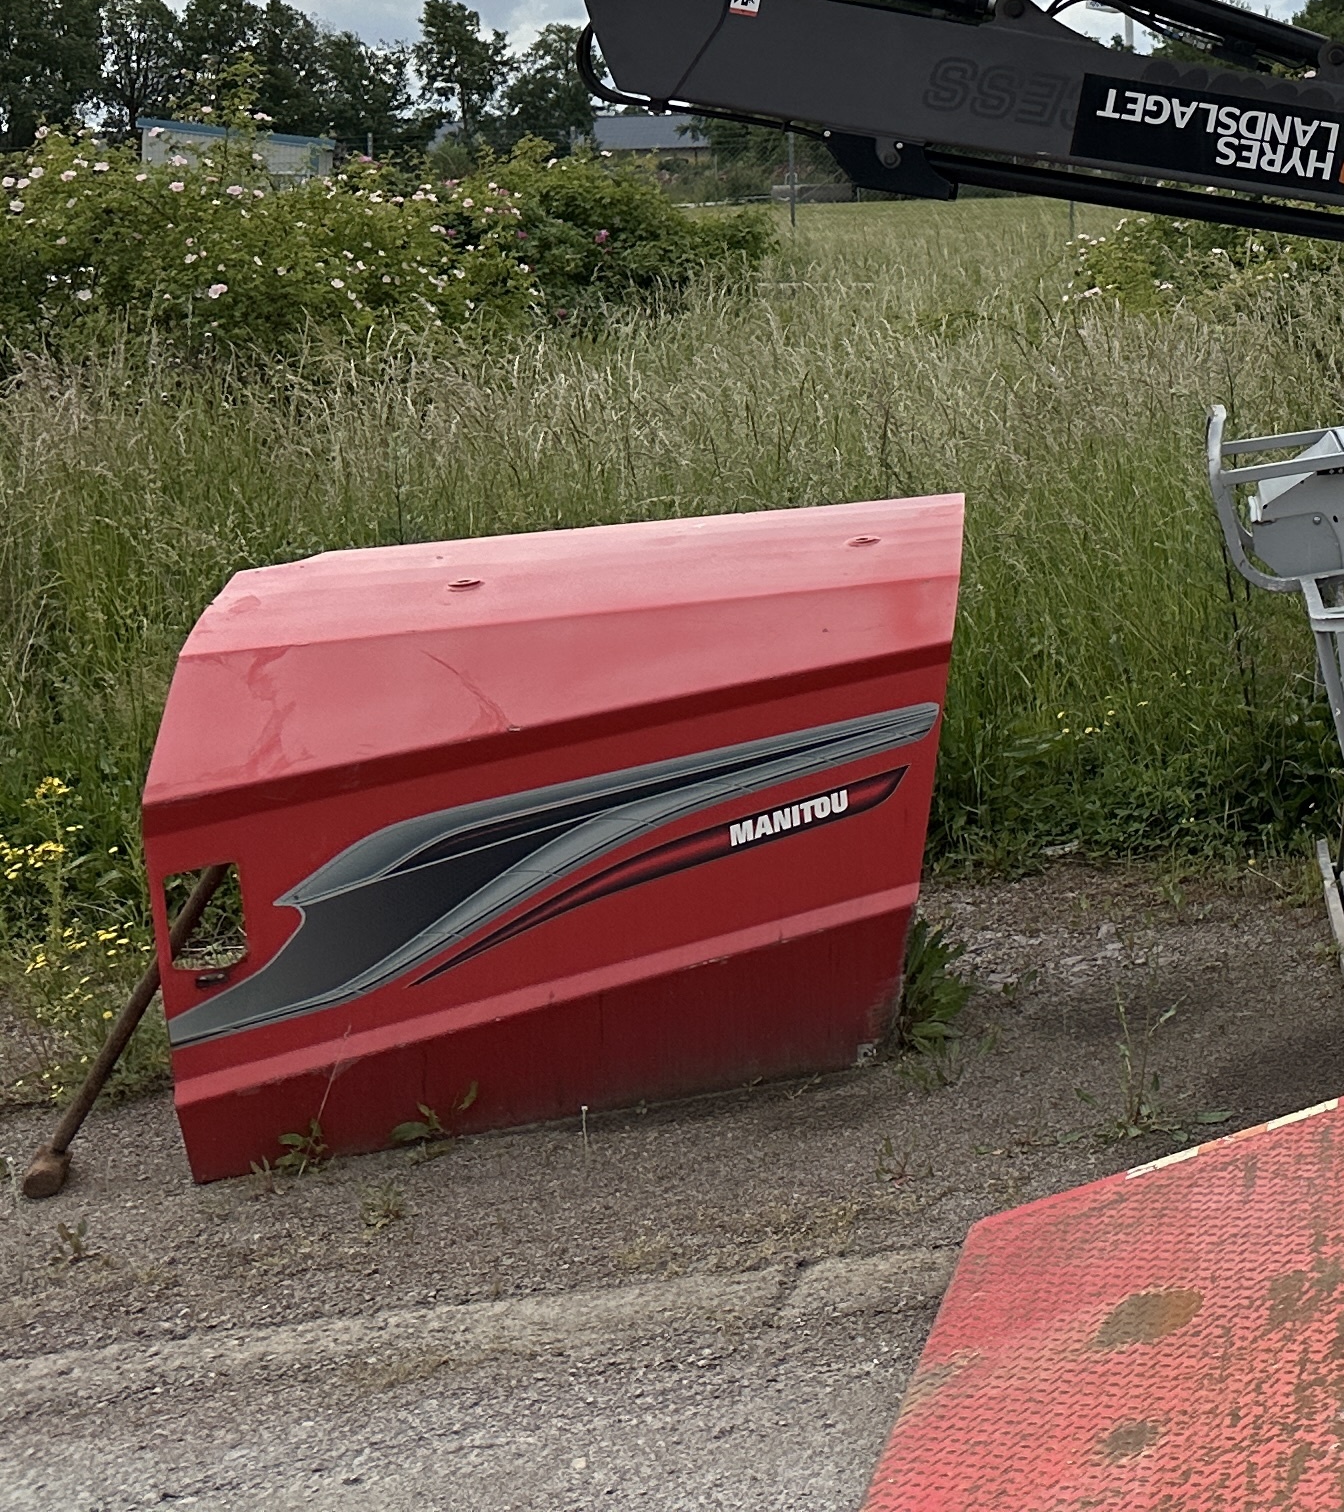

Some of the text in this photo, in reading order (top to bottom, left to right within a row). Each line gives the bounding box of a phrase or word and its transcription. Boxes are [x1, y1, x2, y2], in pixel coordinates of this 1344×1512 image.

[1096, 88, 1340, 151] LANDSLAGET
[1215, 136, 1336, 181] HYRES
[729, 789, 849, 847] MANITOU
